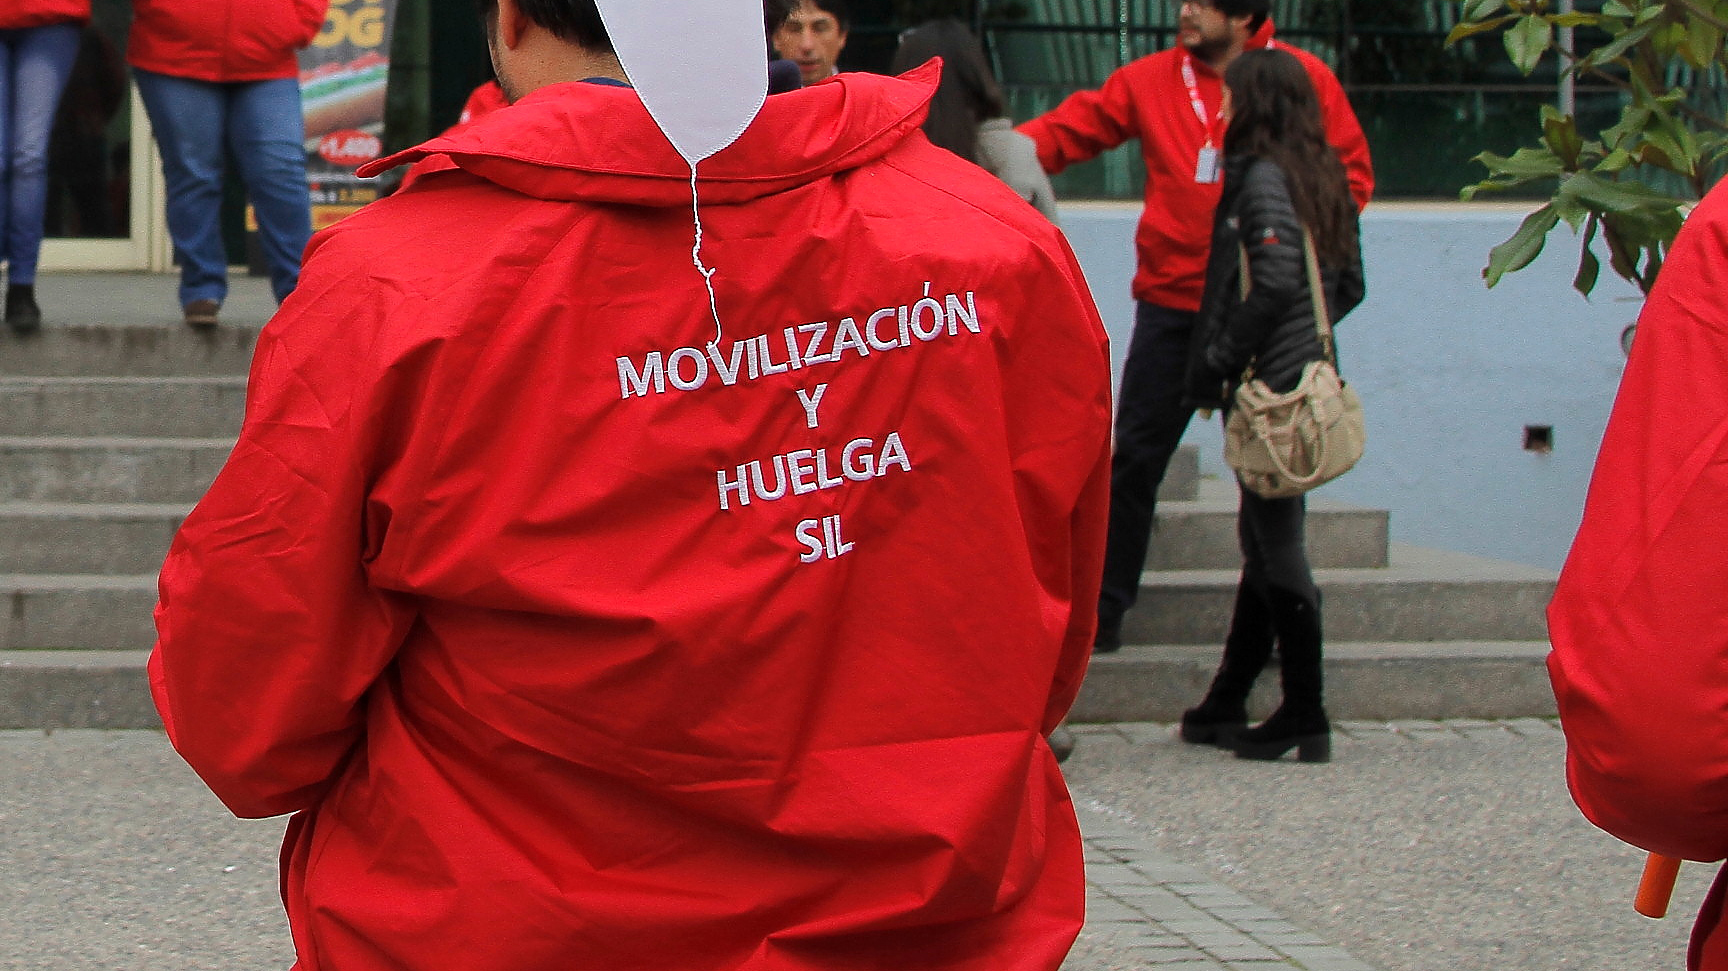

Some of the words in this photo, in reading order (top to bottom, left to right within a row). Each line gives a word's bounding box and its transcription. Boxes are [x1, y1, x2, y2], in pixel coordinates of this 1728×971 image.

[313, 6, 385, 49] OG
[616, 281, 981, 399] MOVILIZACIÓN
[796, 383, 828, 428] Y
[716, 432, 912, 510] HUELGA
[795, 514, 855, 563] SIL
